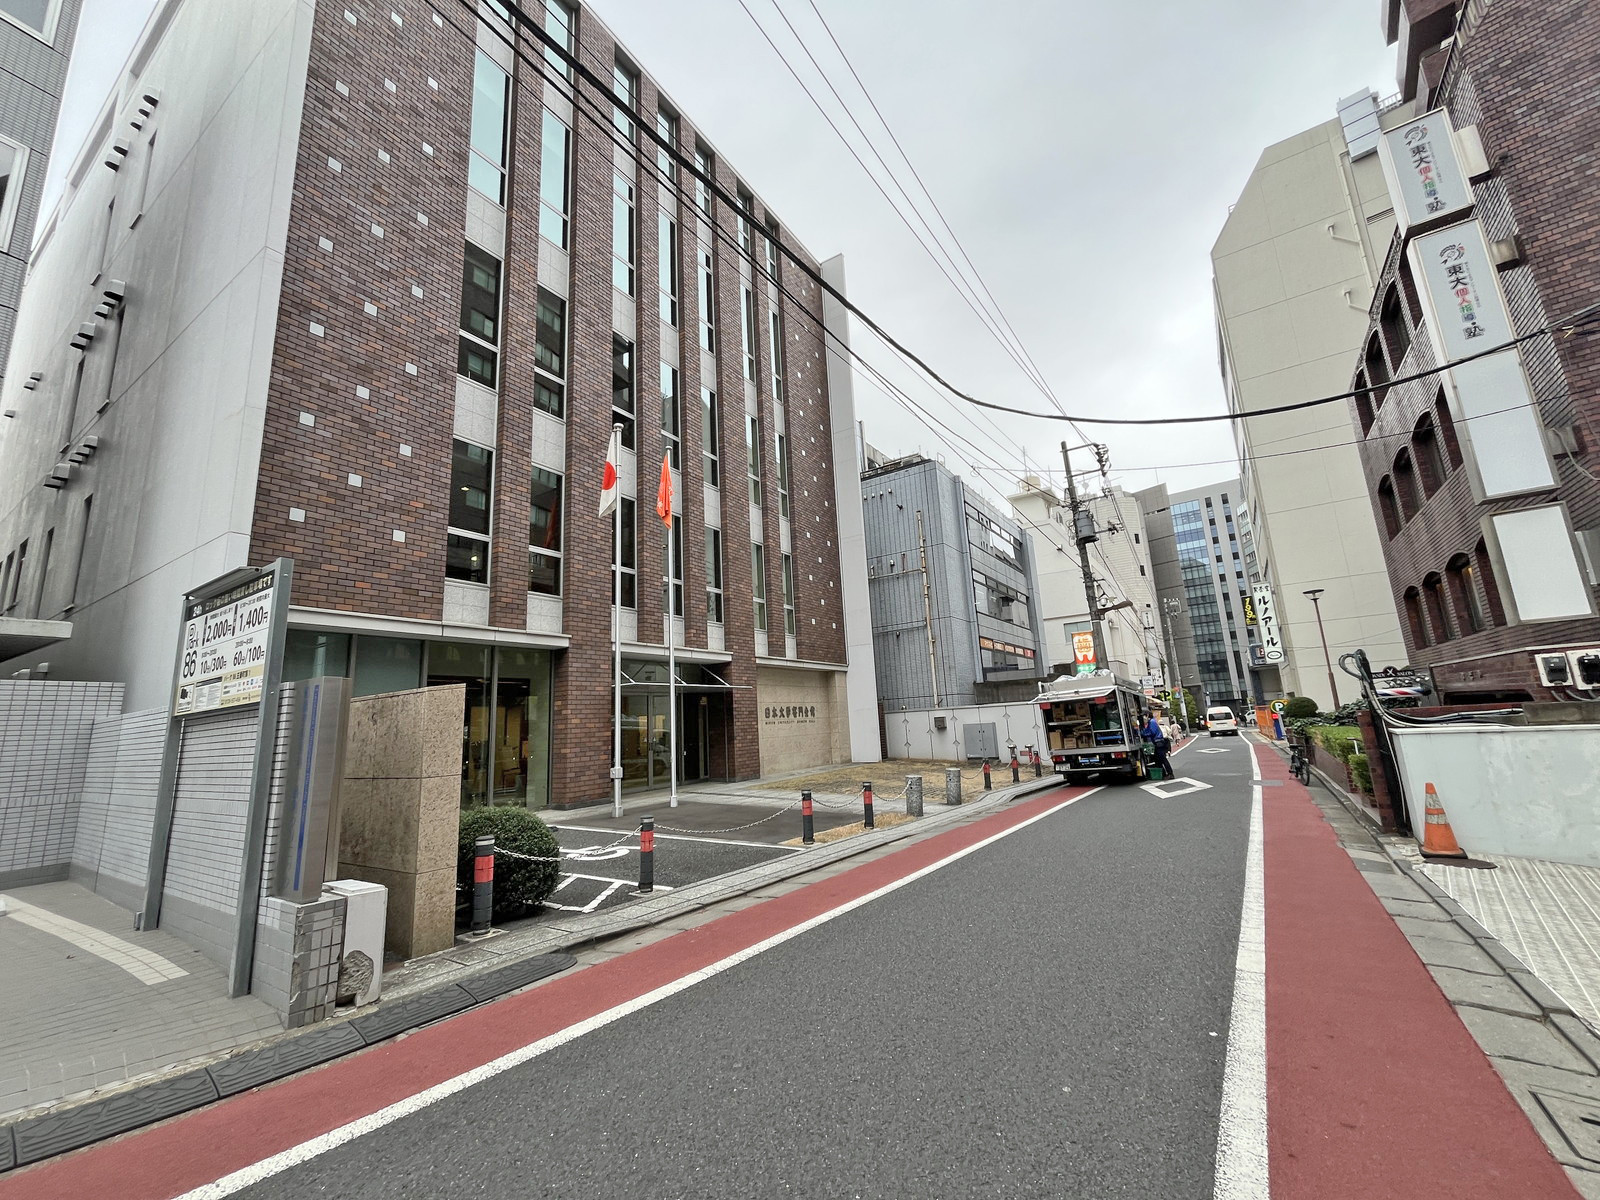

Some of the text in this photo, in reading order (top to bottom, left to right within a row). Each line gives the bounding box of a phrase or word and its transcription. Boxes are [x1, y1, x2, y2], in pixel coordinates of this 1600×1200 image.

[1258, 596, 1278, 648] ルノアール
[183, 650, 197, 678] 86
[1274, 703, 1284, 711] P
